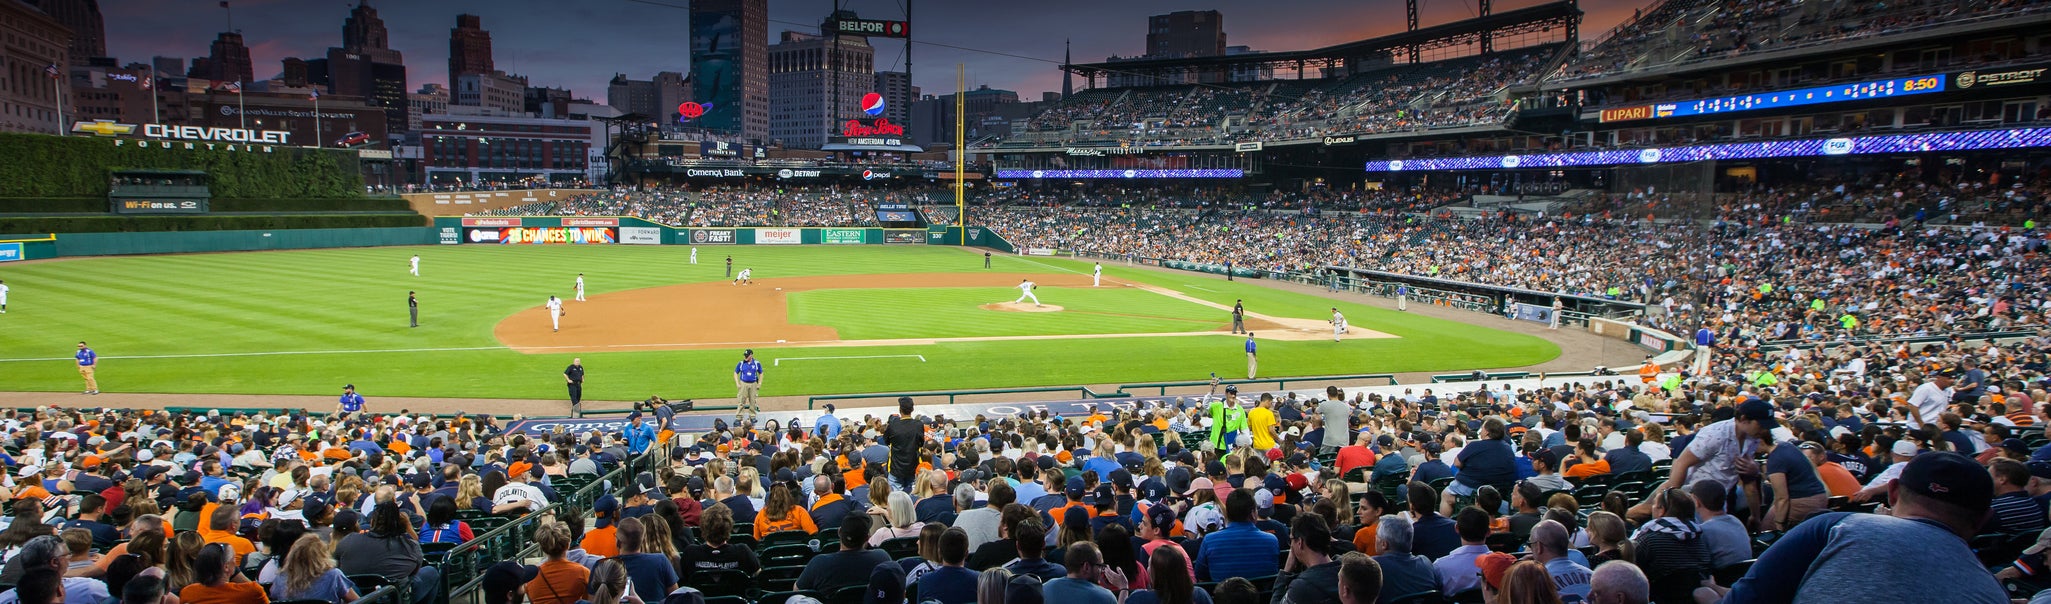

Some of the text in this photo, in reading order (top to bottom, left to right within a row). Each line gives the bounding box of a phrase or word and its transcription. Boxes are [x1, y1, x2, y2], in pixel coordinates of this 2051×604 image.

[839, 21, 884, 32] BELFOR
[1977, 68, 2048, 82] DETROIT
[1904, 77, 1938, 91] 8:50
[311, 111, 355, 119] UNIVERSITY
[1607, 107, 1646, 121] LIPARI
[144, 124, 290, 143] CHEVROLET
[115, 140, 272, 153] FOUNTAIN
[717, 141, 729, 151] Lite
[724, 168, 744, 176] Bank
[125, 201, 150, 209] Wi-Fi
[523, 229, 566, 242] CHANCES
[568, 229, 581, 242] TO
[765, 229, 791, 239] meijer
[826, 229, 861, 237] EASTERN
[499, 488, 527, 500] COLAVITO
